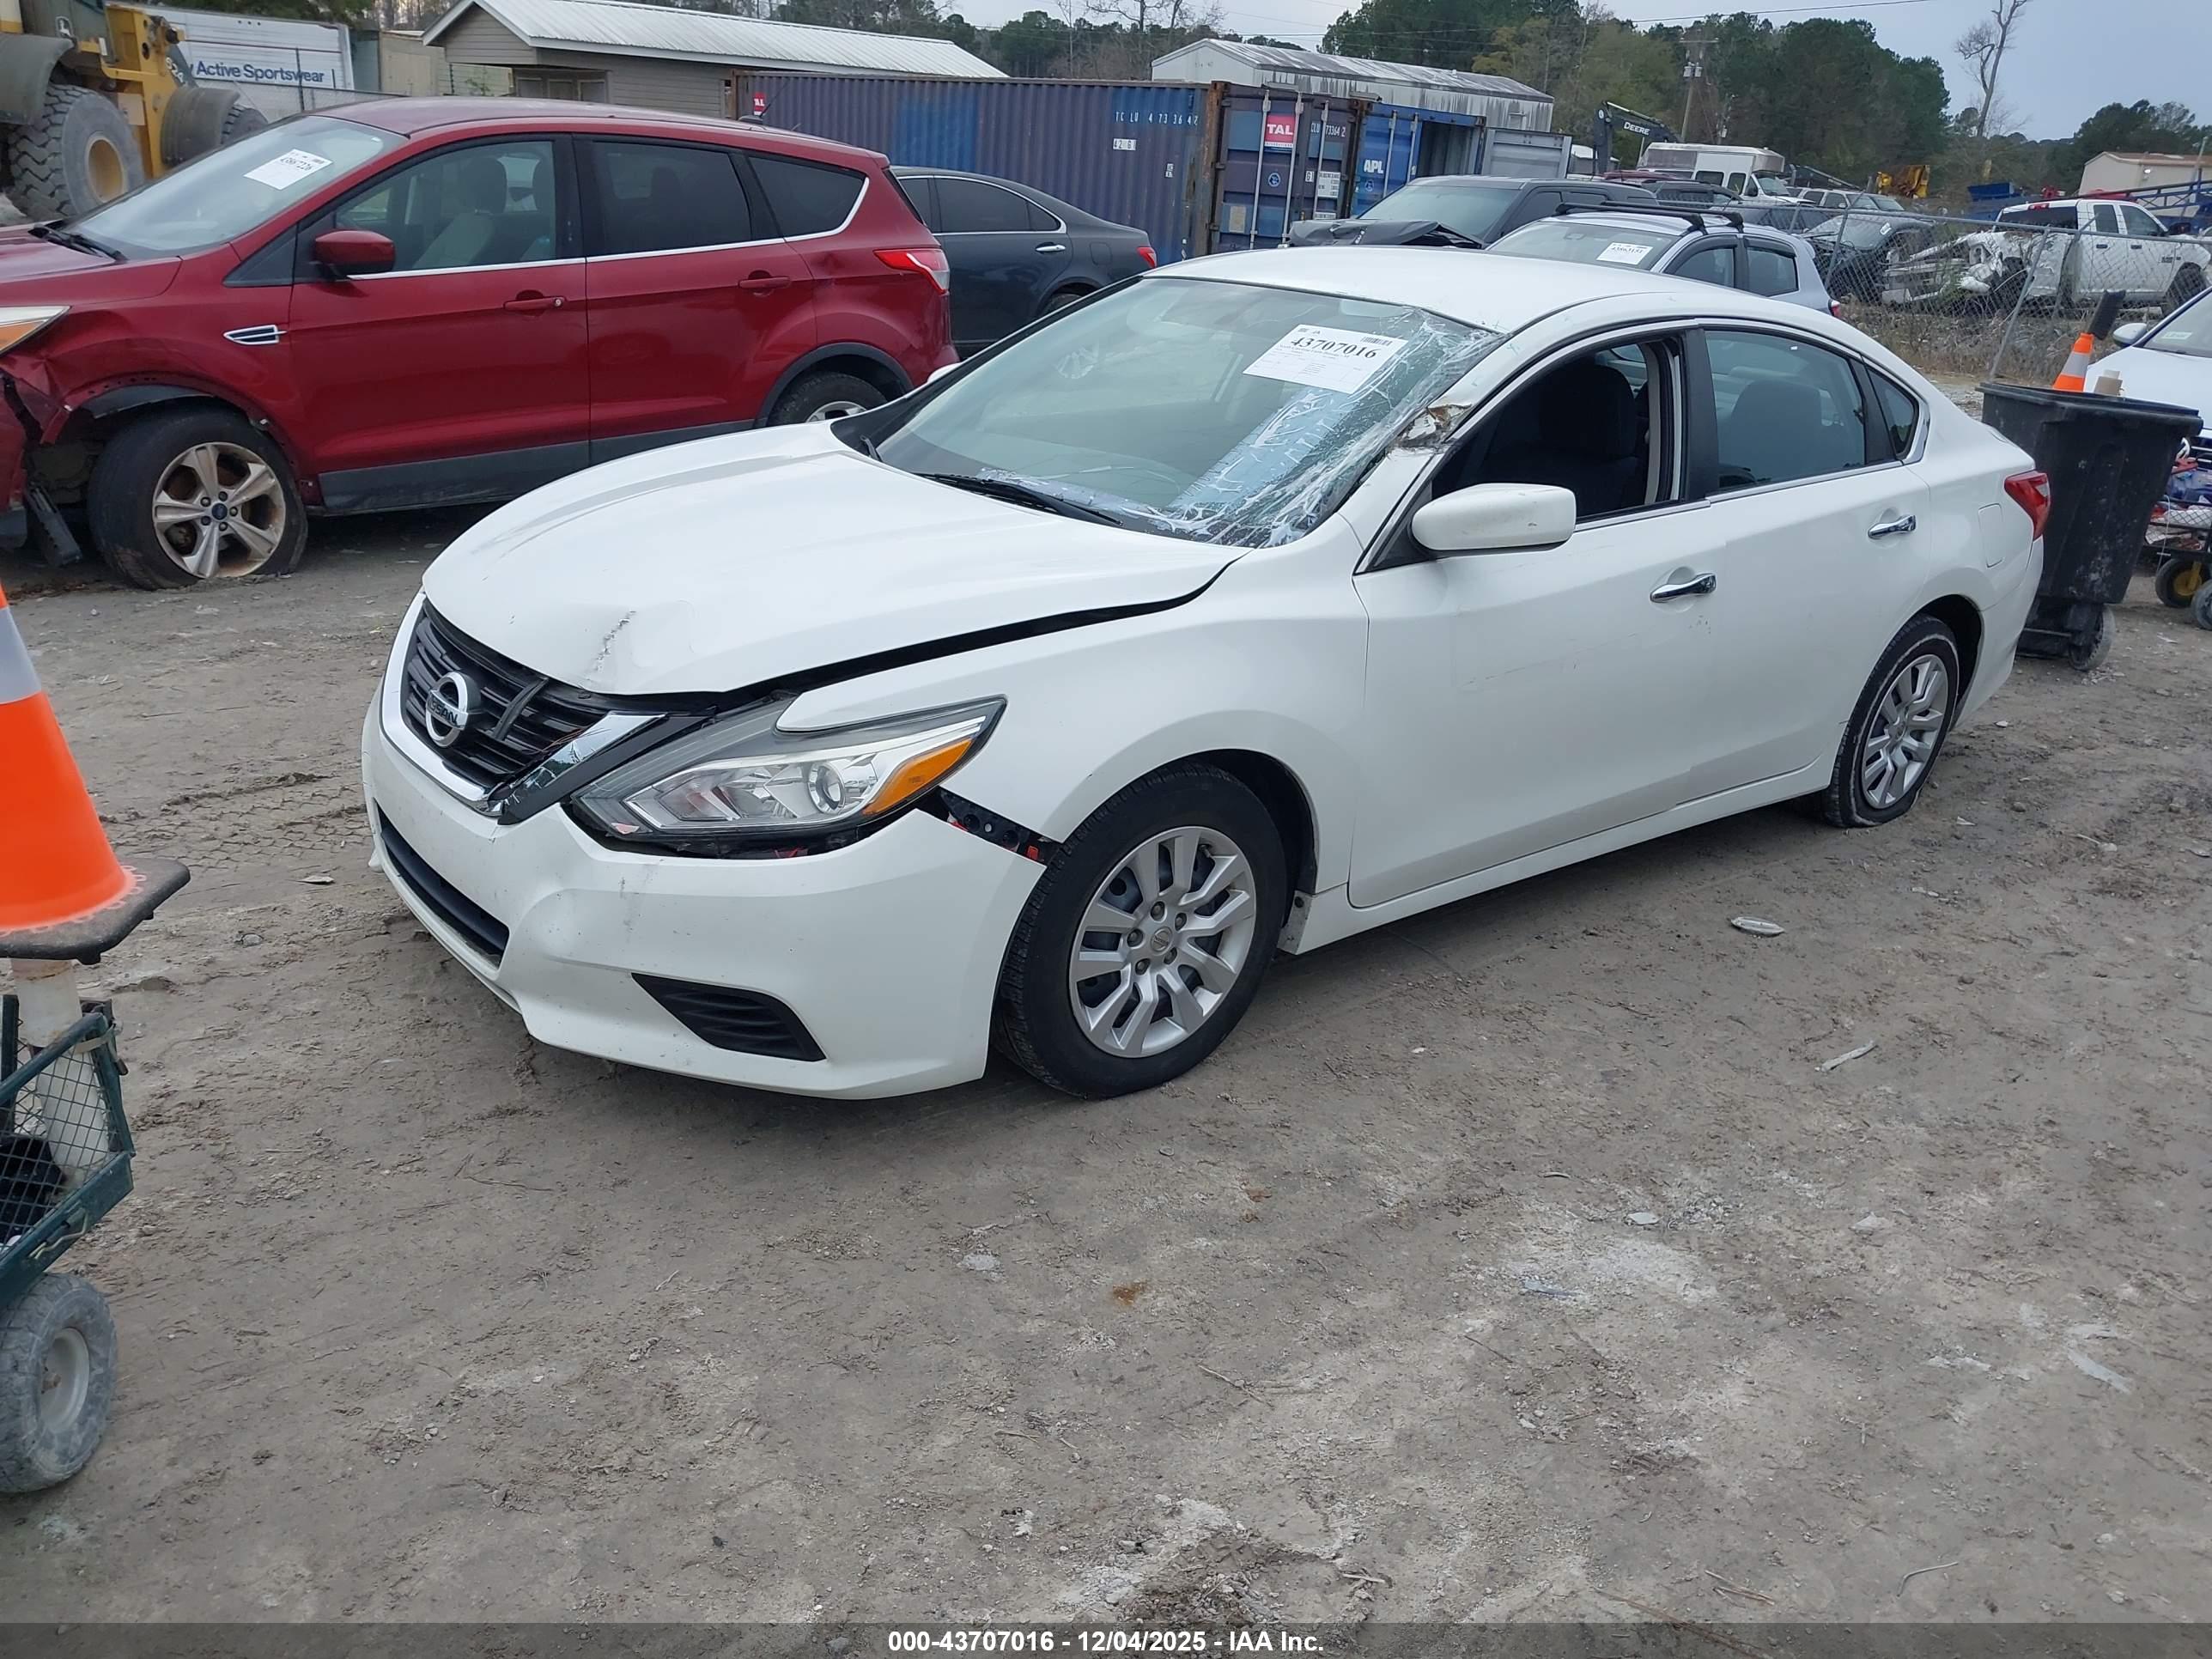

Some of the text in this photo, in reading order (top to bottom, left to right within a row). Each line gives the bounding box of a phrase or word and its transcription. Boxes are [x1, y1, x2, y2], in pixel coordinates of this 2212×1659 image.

[197, 61, 240, 77] Active
[243, 64, 325, 82] Sportswear
[1267, 124, 1294, 136] TAL
[1623, 122, 1650, 136] DEERE
[1364, 160, 1384, 174] APL
[1291, 337, 1382, 359] 43707016
